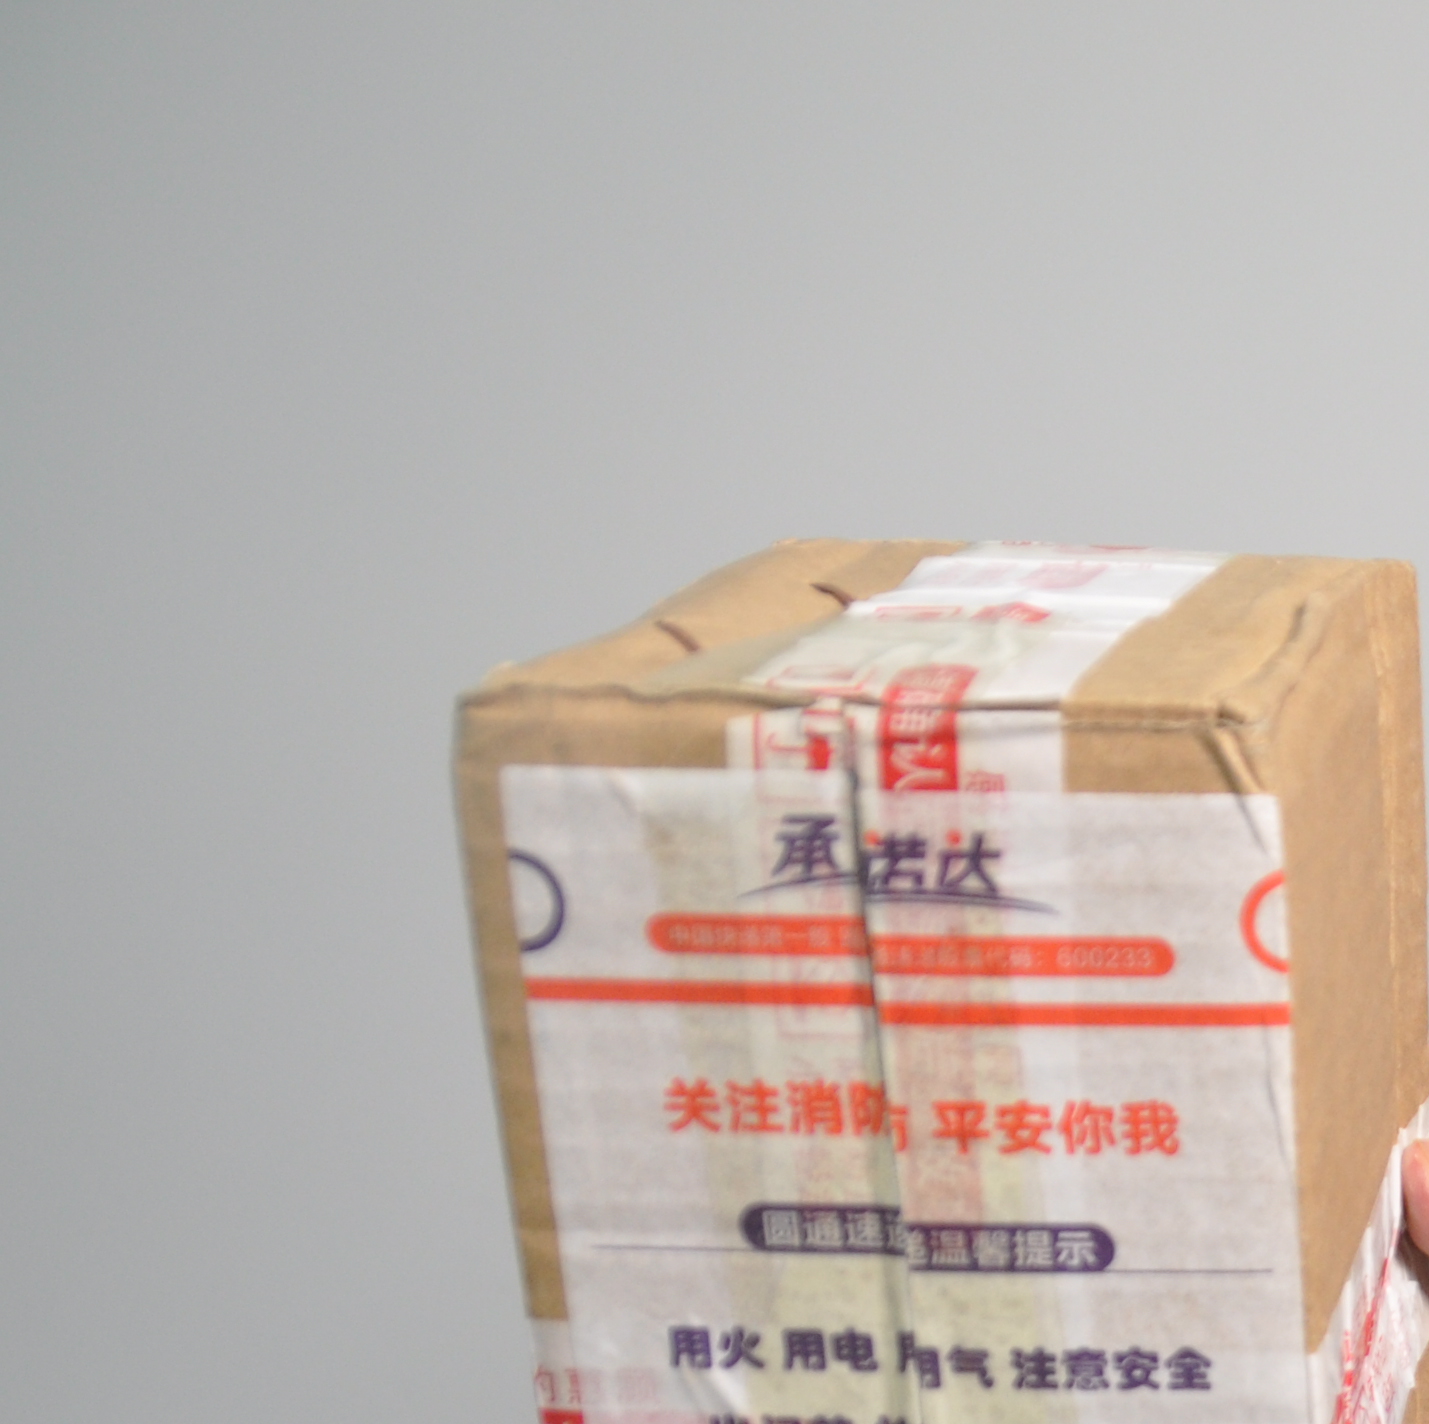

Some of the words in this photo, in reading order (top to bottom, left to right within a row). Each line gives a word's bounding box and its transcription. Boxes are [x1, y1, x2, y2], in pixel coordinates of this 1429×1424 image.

[771, 814, 1002, 897] 承诺达
[664, 1078, 908, 1153] 关注消防
[932, 1100, 1180, 1155] 平安你我
[670, 1326, 765, 1370] 用火
[782, 1328, 878, 1373] 用电
[899, 1330, 994, 1389] 用气
[1011, 1346, 1213, 1391] 注意安全
